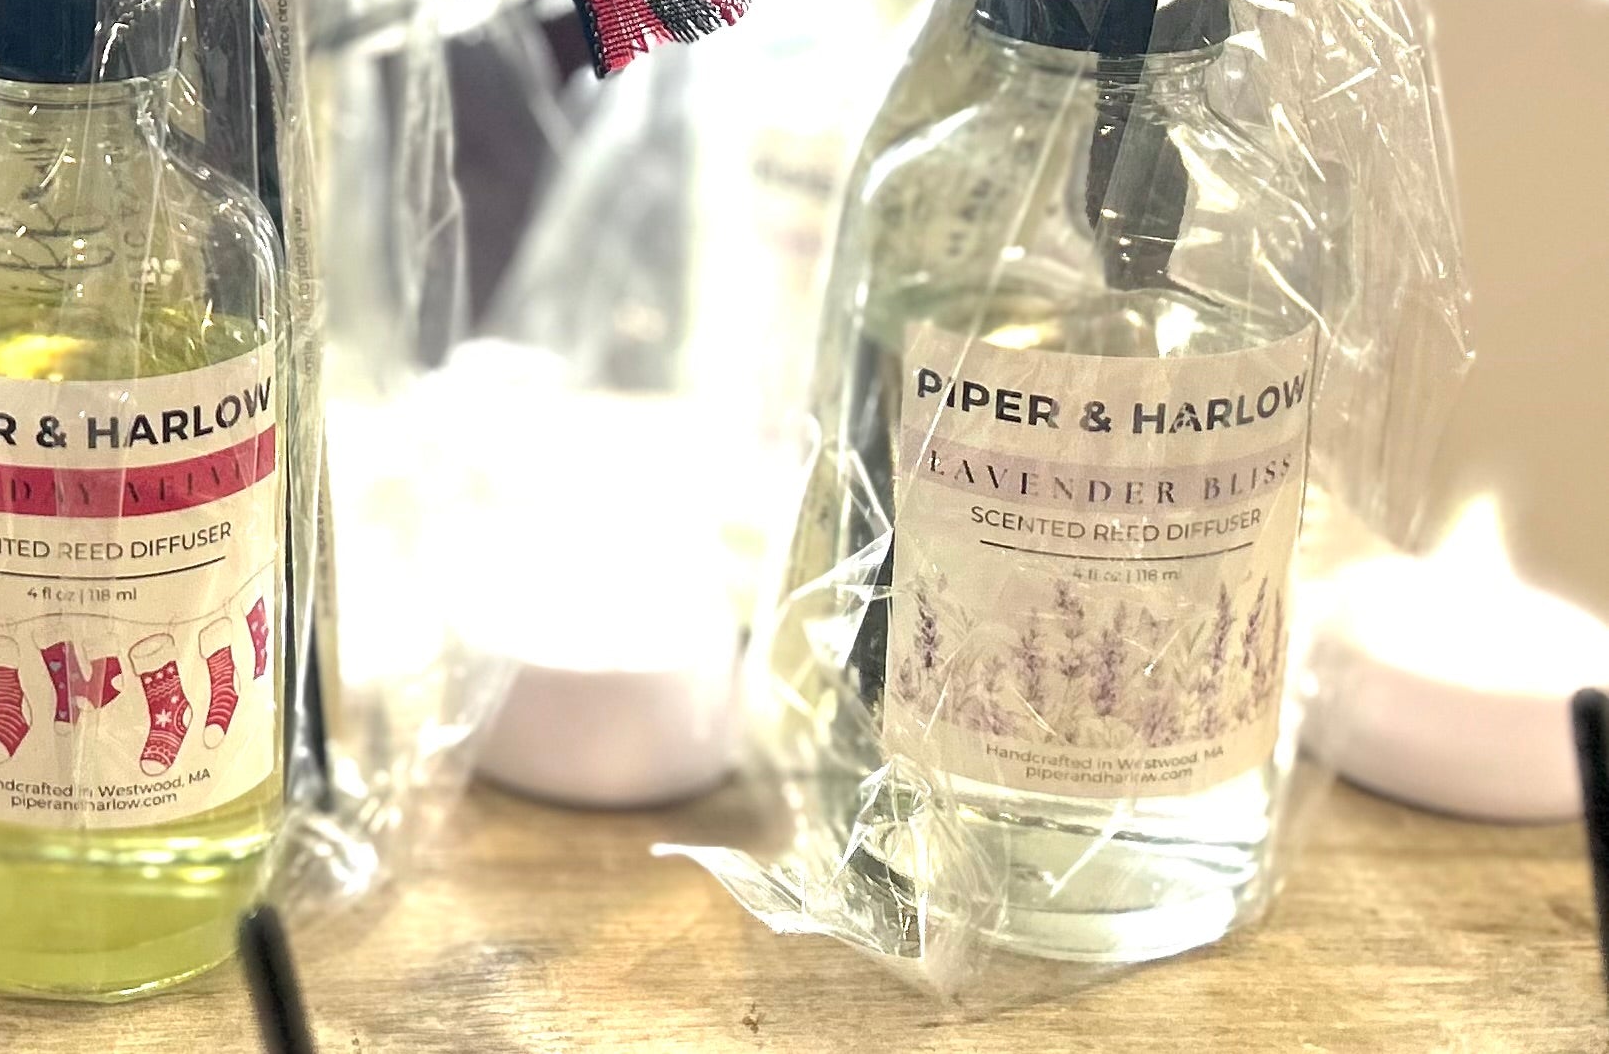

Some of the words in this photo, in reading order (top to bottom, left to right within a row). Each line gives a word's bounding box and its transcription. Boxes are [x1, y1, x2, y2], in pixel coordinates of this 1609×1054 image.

[36, 415, 67, 448] &
[88, 377, 272, 449] HARLOW
[916, 367, 1060, 430] PIPER
[1079, 400, 1112, 434] &
[1132, 369, 1308, 435] HARLOW
[928, 448, 1176, 504] LAVENDER
[1203, 452, 1293, 502] BLISS
[58, 542, 123, 561] REED
[131, 521, 231, 559] DIFFUSER
[970, 505, 1086, 540] SCENTED
[1092, 520, 1160, 542] REED
[1166, 508, 1263, 541] DIFFUSER
[26, 586, 38, 600] 4
[42, 586, 52, 601] fl
[87, 588, 111, 602] 118
[116, 587, 137, 601] ml
[986, 743, 1092, 770] Handcrafted
[1098, 758, 1112, 770] in
[1204, 745, 1225, 762] MA
[98, 775, 186, 799] Westwood,
[188, 767, 211, 785] MA
